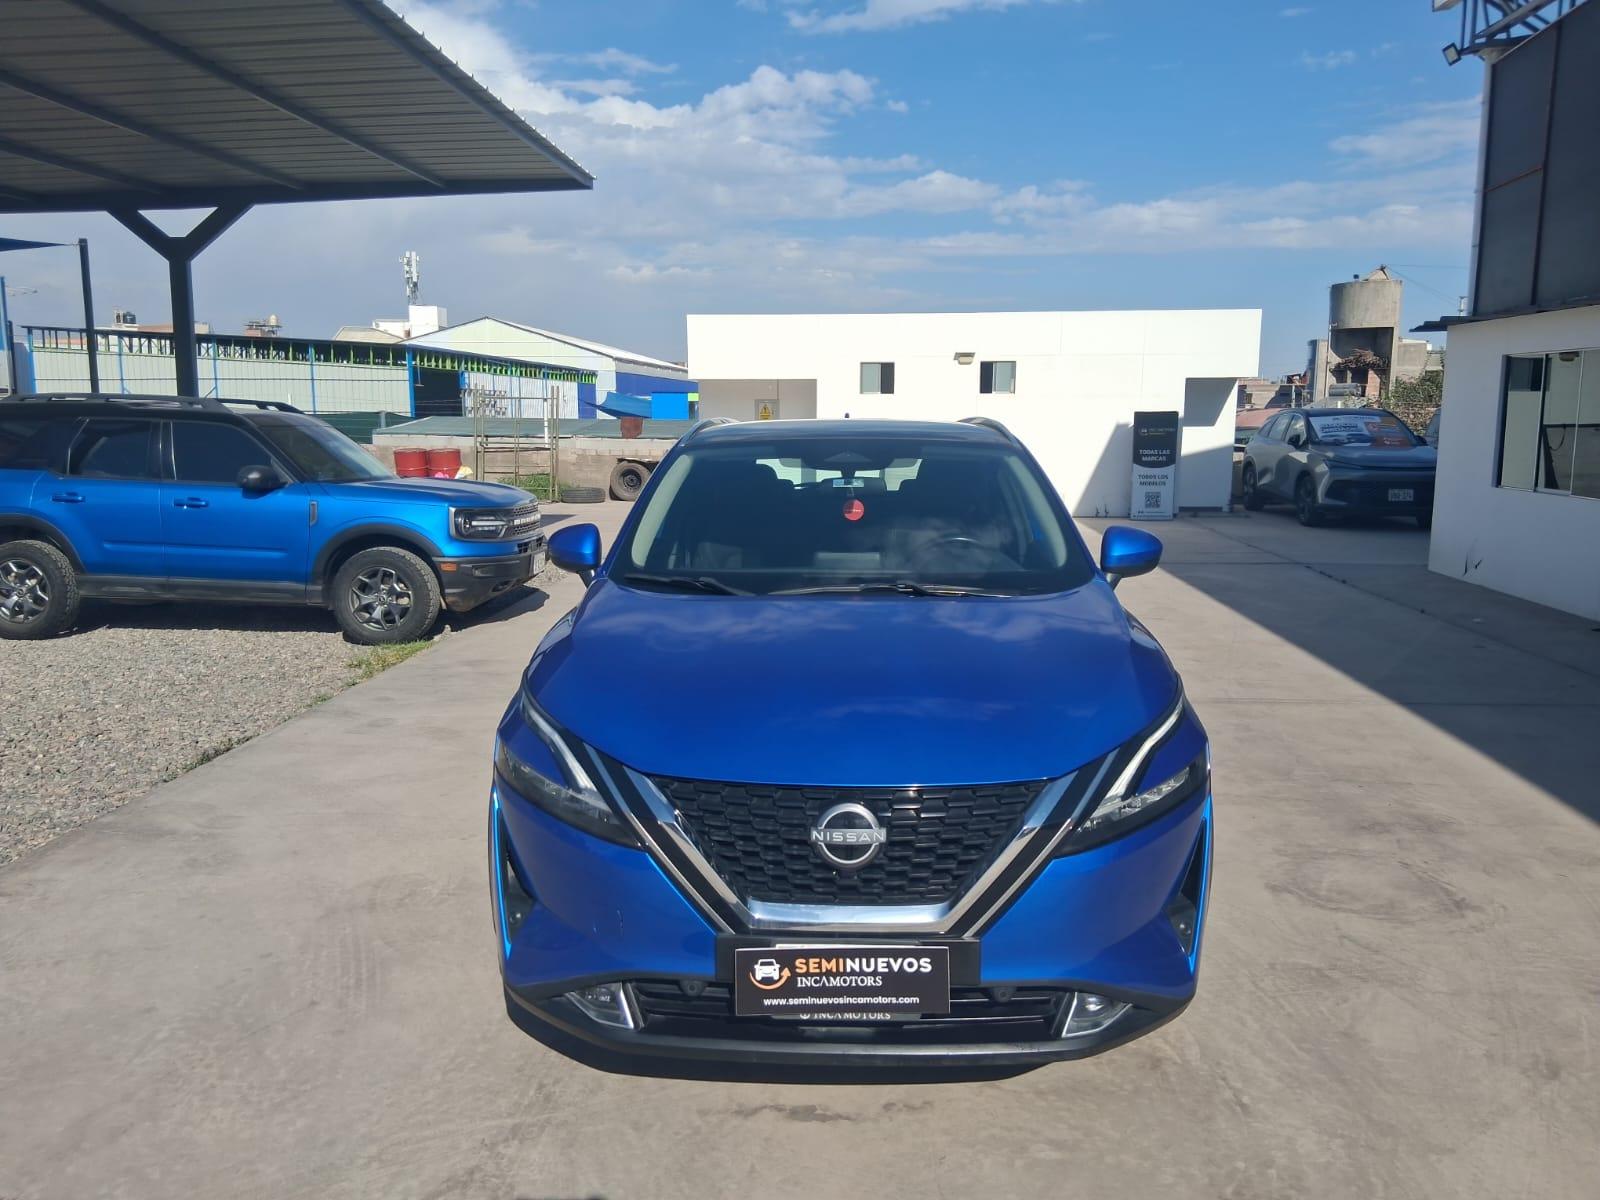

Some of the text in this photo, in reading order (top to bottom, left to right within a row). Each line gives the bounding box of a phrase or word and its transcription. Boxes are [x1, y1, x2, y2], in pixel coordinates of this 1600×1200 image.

[812, 831, 885, 842] NISSAN
[795, 957, 932, 974] SEMINUEVOS
[797, 975, 883, 988] INCAMOTORS
[763, 995, 920, 1006] www.seminuevosincamotors.com
